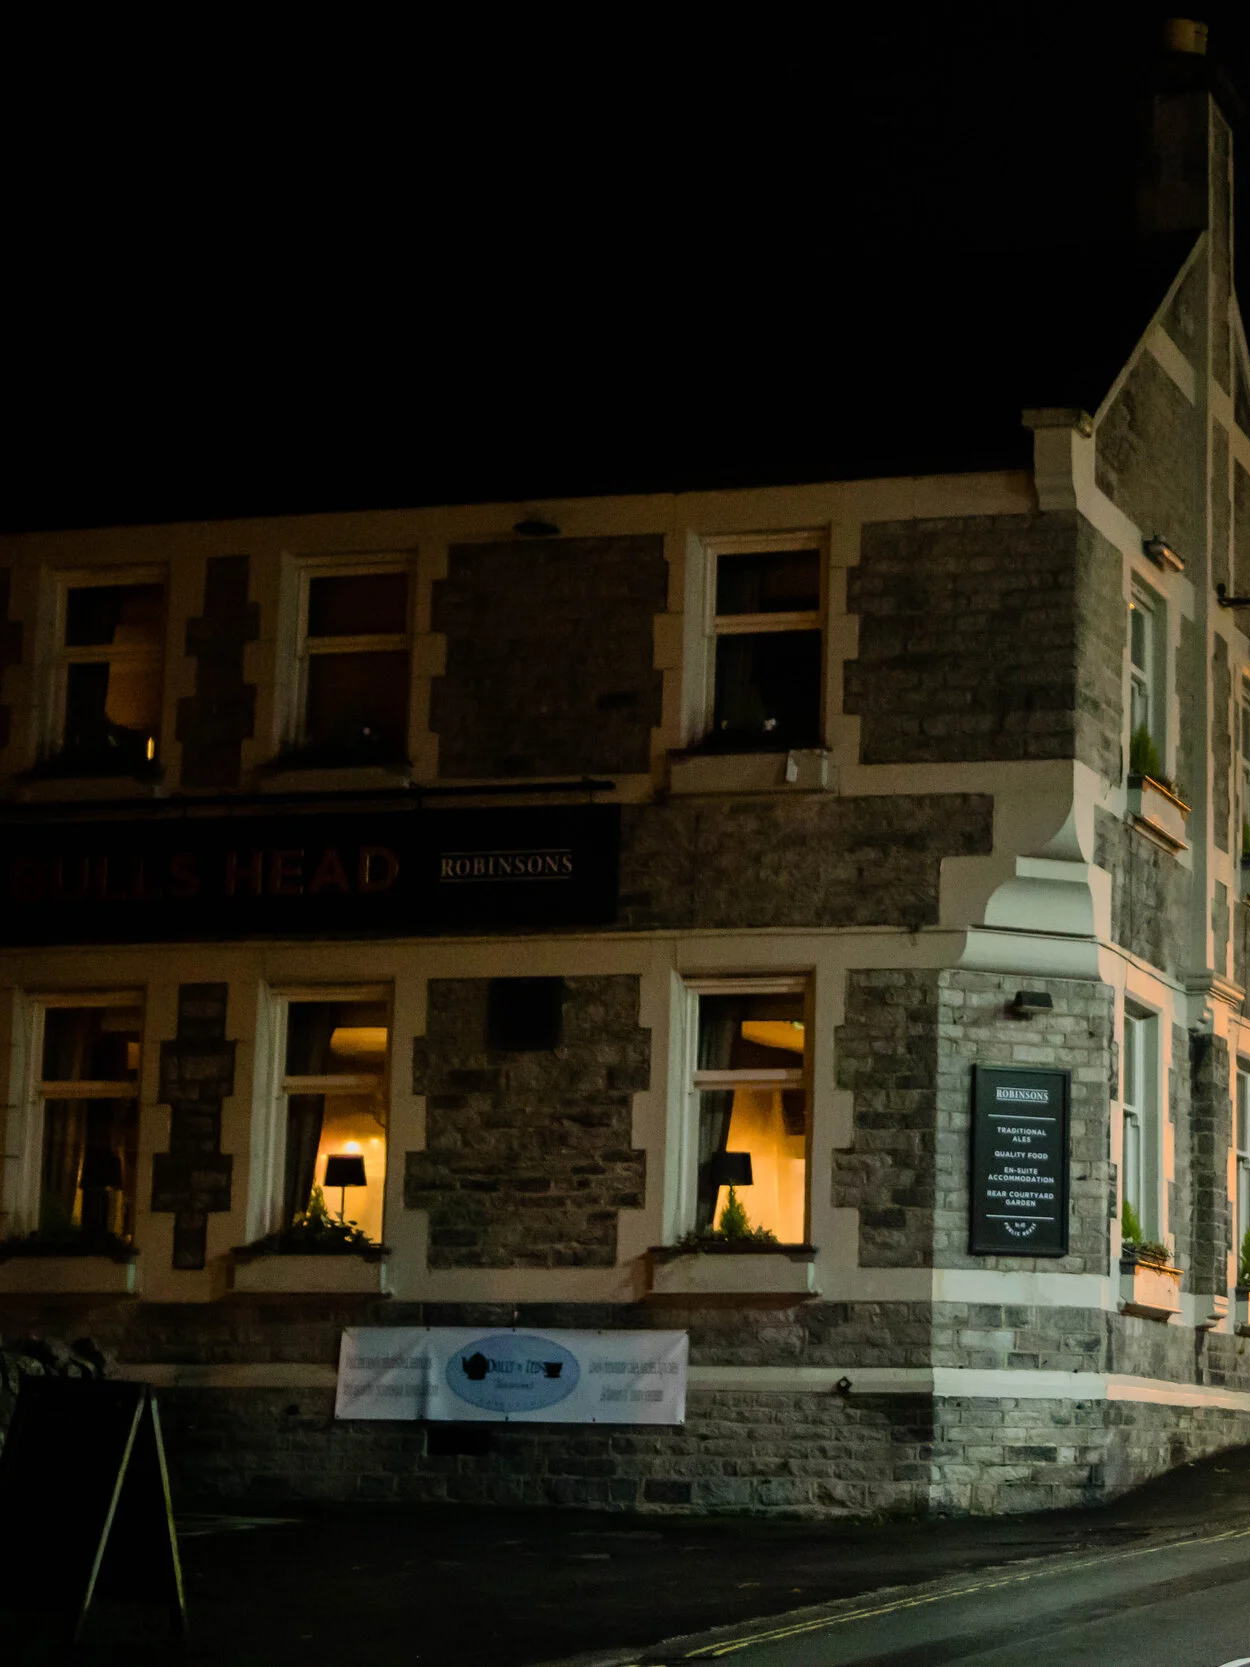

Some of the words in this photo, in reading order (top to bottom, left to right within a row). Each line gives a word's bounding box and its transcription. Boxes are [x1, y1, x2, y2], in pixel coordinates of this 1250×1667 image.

[224, 845, 400, 896] HEAD
[440, 853, 573, 878] ROBINSONS
[996, 1089, 1049, 1101] ROBINSONS
[997, 1126, 1047, 1136] TRADITIONAL
[1012, 1135, 1031, 1143] ALES
[994, 1150, 1026, 1159] QUALITY
[1028, 1152, 1049, 1160] FOOD
[1004, 1166, 1038, 1175] EN-SUITE
[988, 1174, 1055, 1184] ACCOMMODATION
[987, 1189, 1007, 1197] REAR
[1009, 1191, 1055, 1200] COURTYARD
[1005, 1199, 1036, 1207] GARDEN
